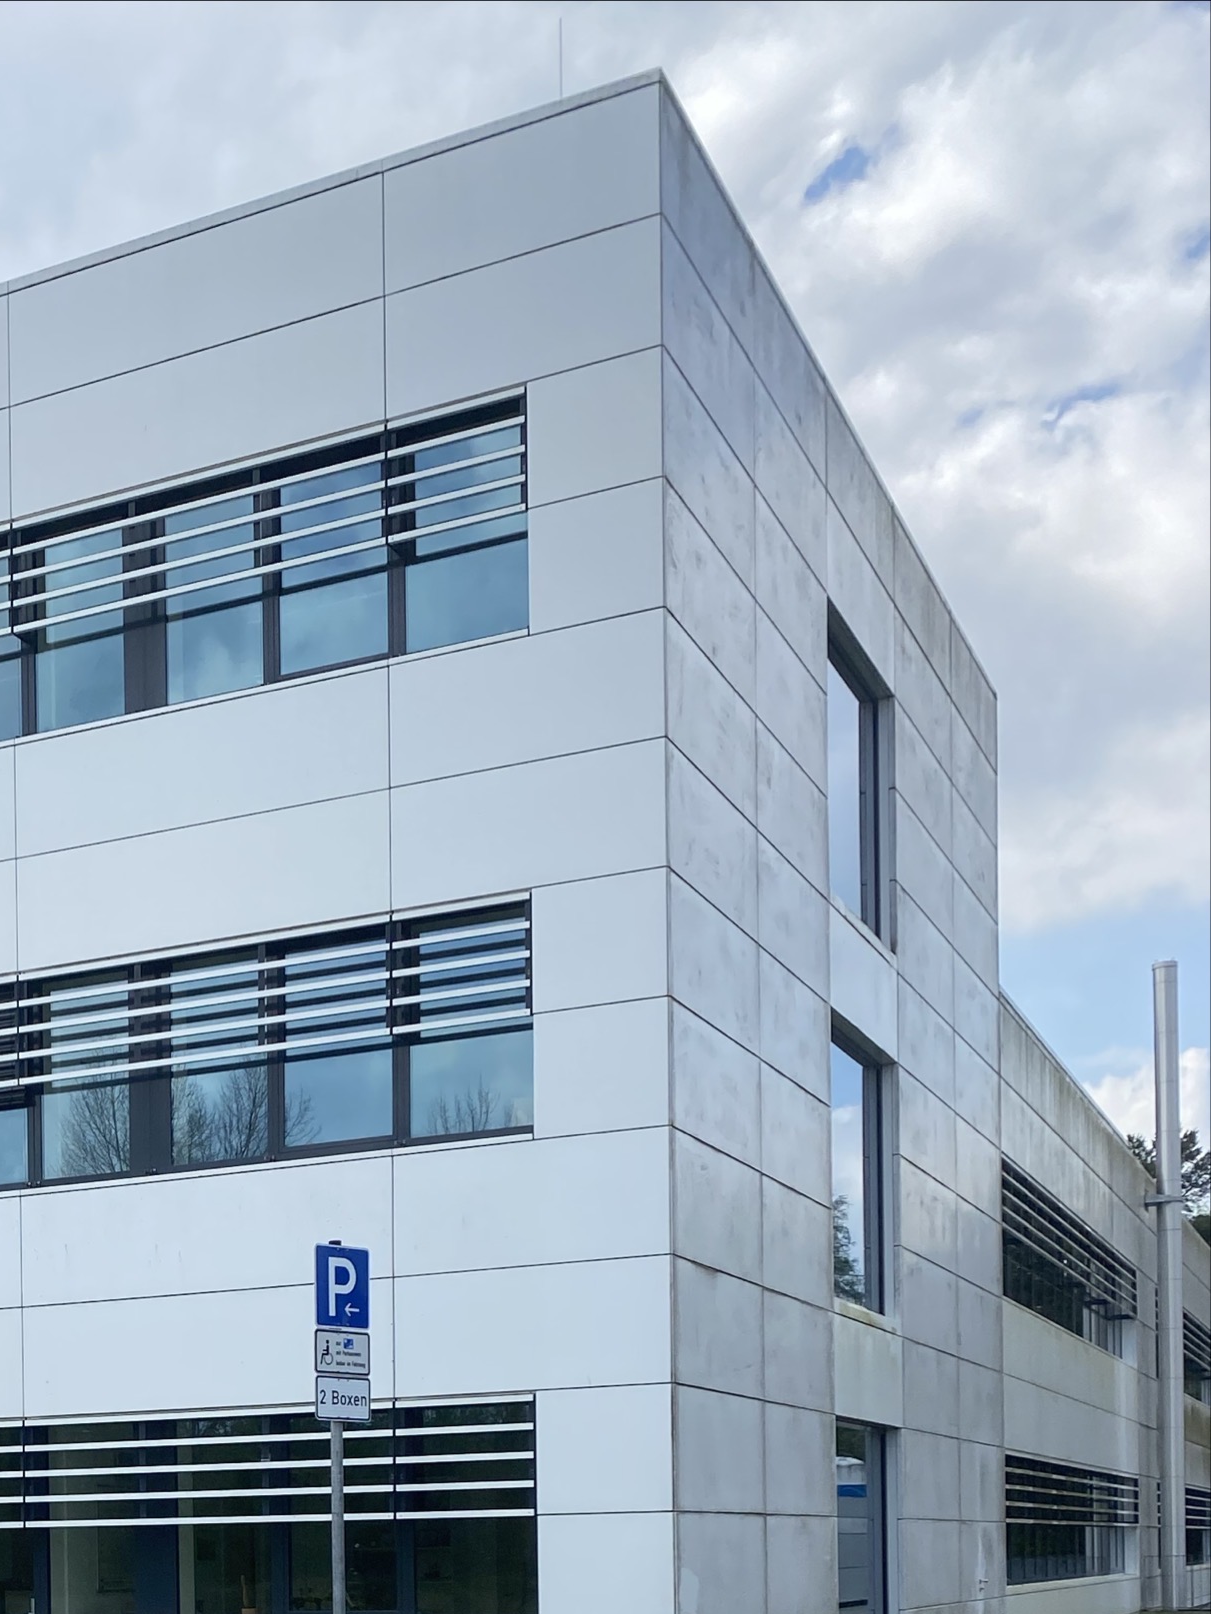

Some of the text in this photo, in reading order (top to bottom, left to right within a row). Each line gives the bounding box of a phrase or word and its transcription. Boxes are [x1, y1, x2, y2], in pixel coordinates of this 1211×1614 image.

[328, 1256, 357, 1316] P
[319, 1389, 367, 1407] 2 Boxen
